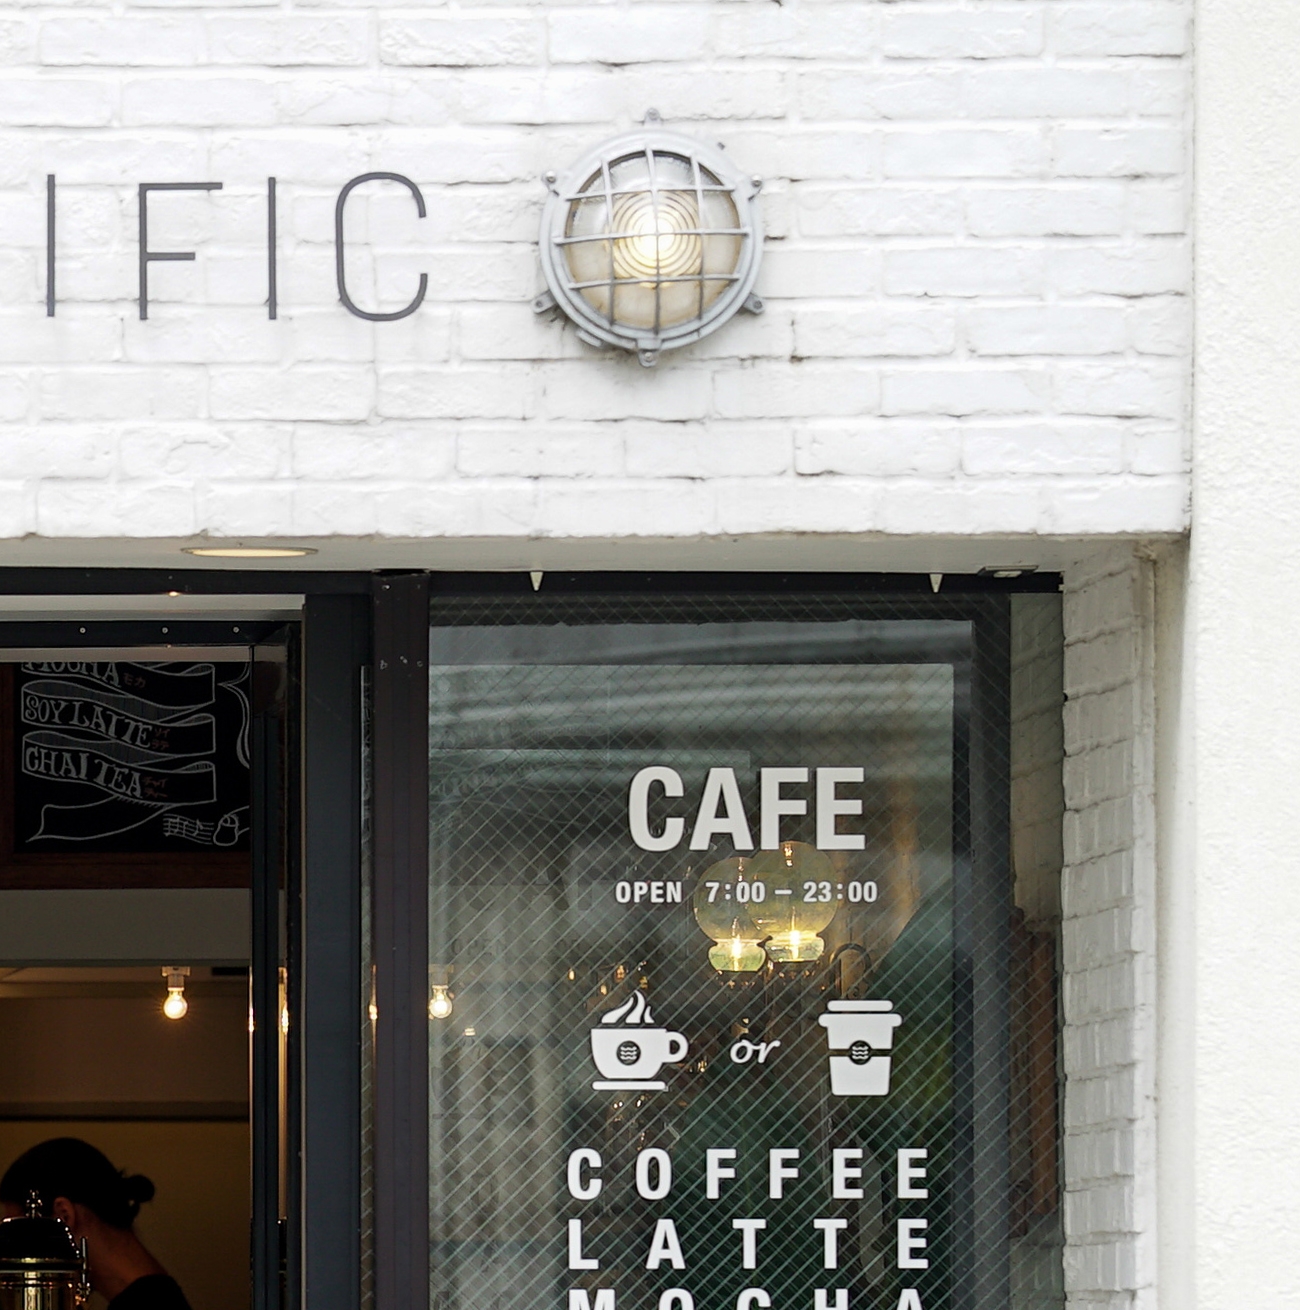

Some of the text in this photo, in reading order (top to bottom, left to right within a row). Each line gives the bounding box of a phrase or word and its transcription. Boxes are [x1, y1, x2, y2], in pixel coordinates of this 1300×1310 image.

[24, 694, 154, 748] SOY LATTE
[25, 746, 144, 799] CHAI TEA
[628, 766, 866, 851] CAFE
[615, 881, 683, 903] OPEN
[705, 881, 766, 903] 7:00
[803, 881, 878, 903] 23:00
[729, 1038, 781, 1065] or
[567, 1148, 929, 1199] COFFEE
[568, 1218, 929, 1270] LATTE
